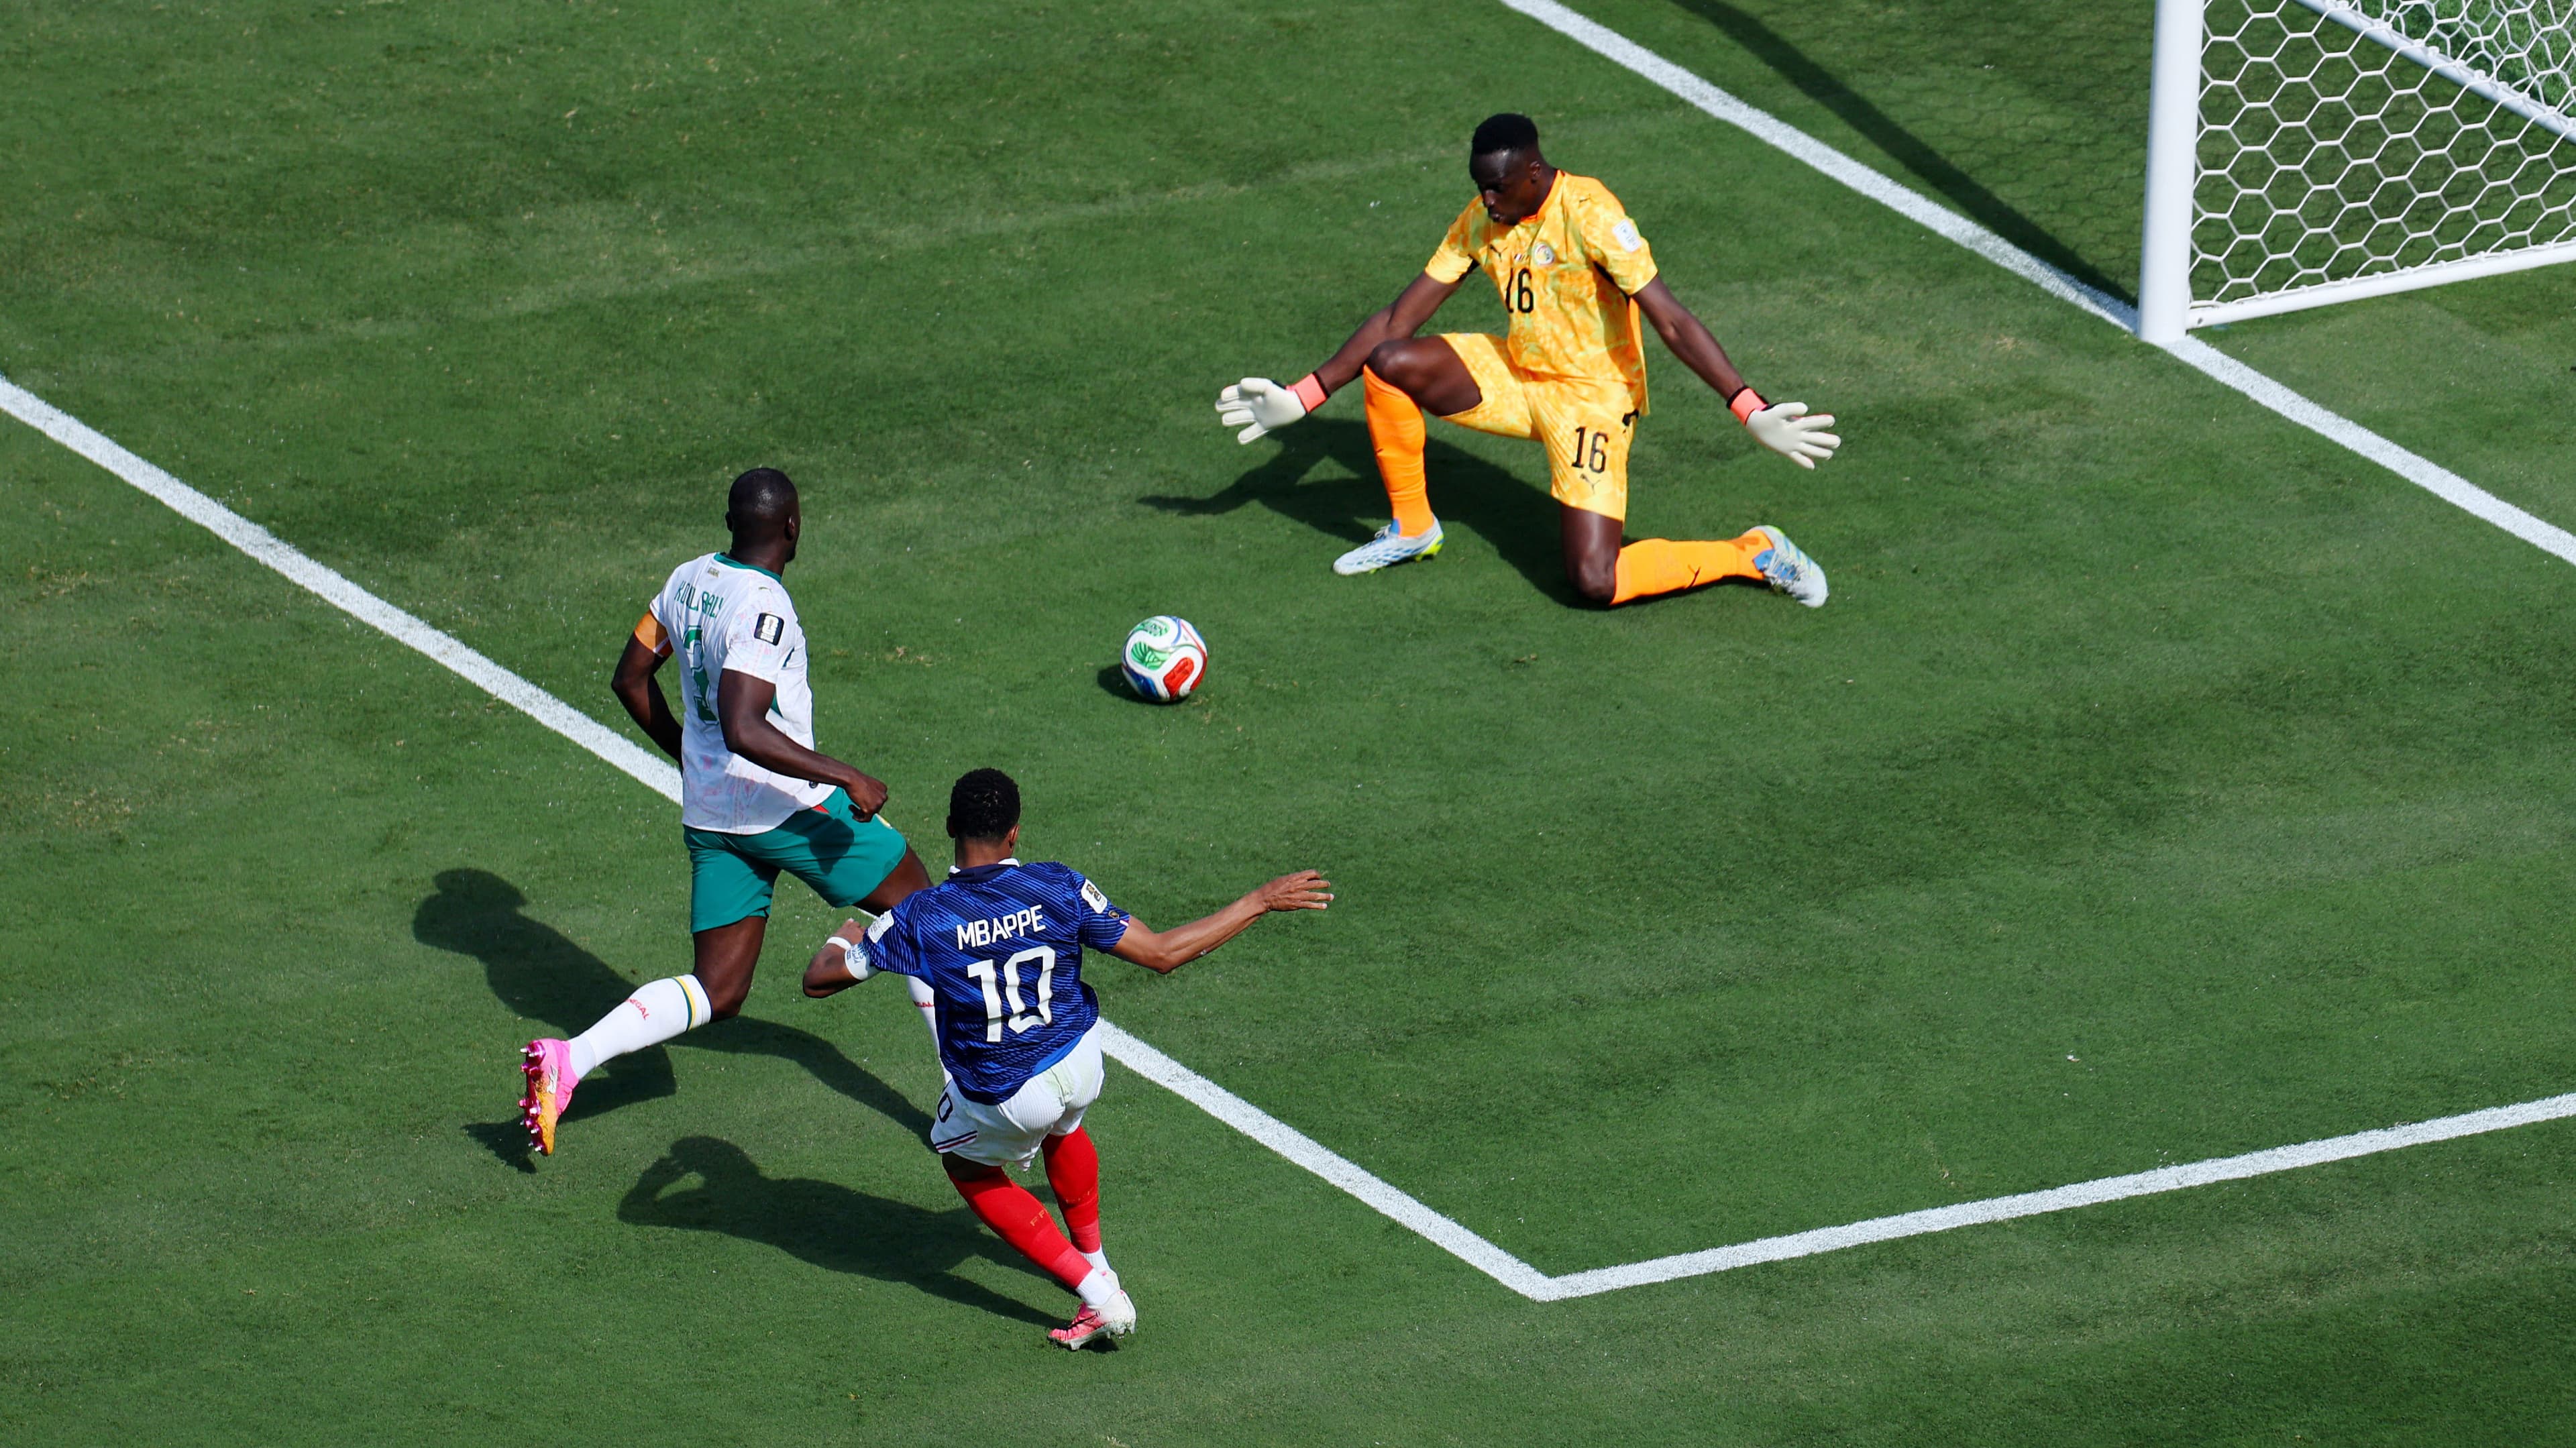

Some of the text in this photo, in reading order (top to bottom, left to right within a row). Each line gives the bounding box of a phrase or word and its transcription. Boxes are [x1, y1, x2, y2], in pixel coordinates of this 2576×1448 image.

[1505, 267, 1534, 313] 16
[1571, 426, 1609, 474] 16
[956, 904, 1046, 950] MBAPPE
[967, 945, 1056, 1042] 10
[937, 1091, 953, 1123] 0
